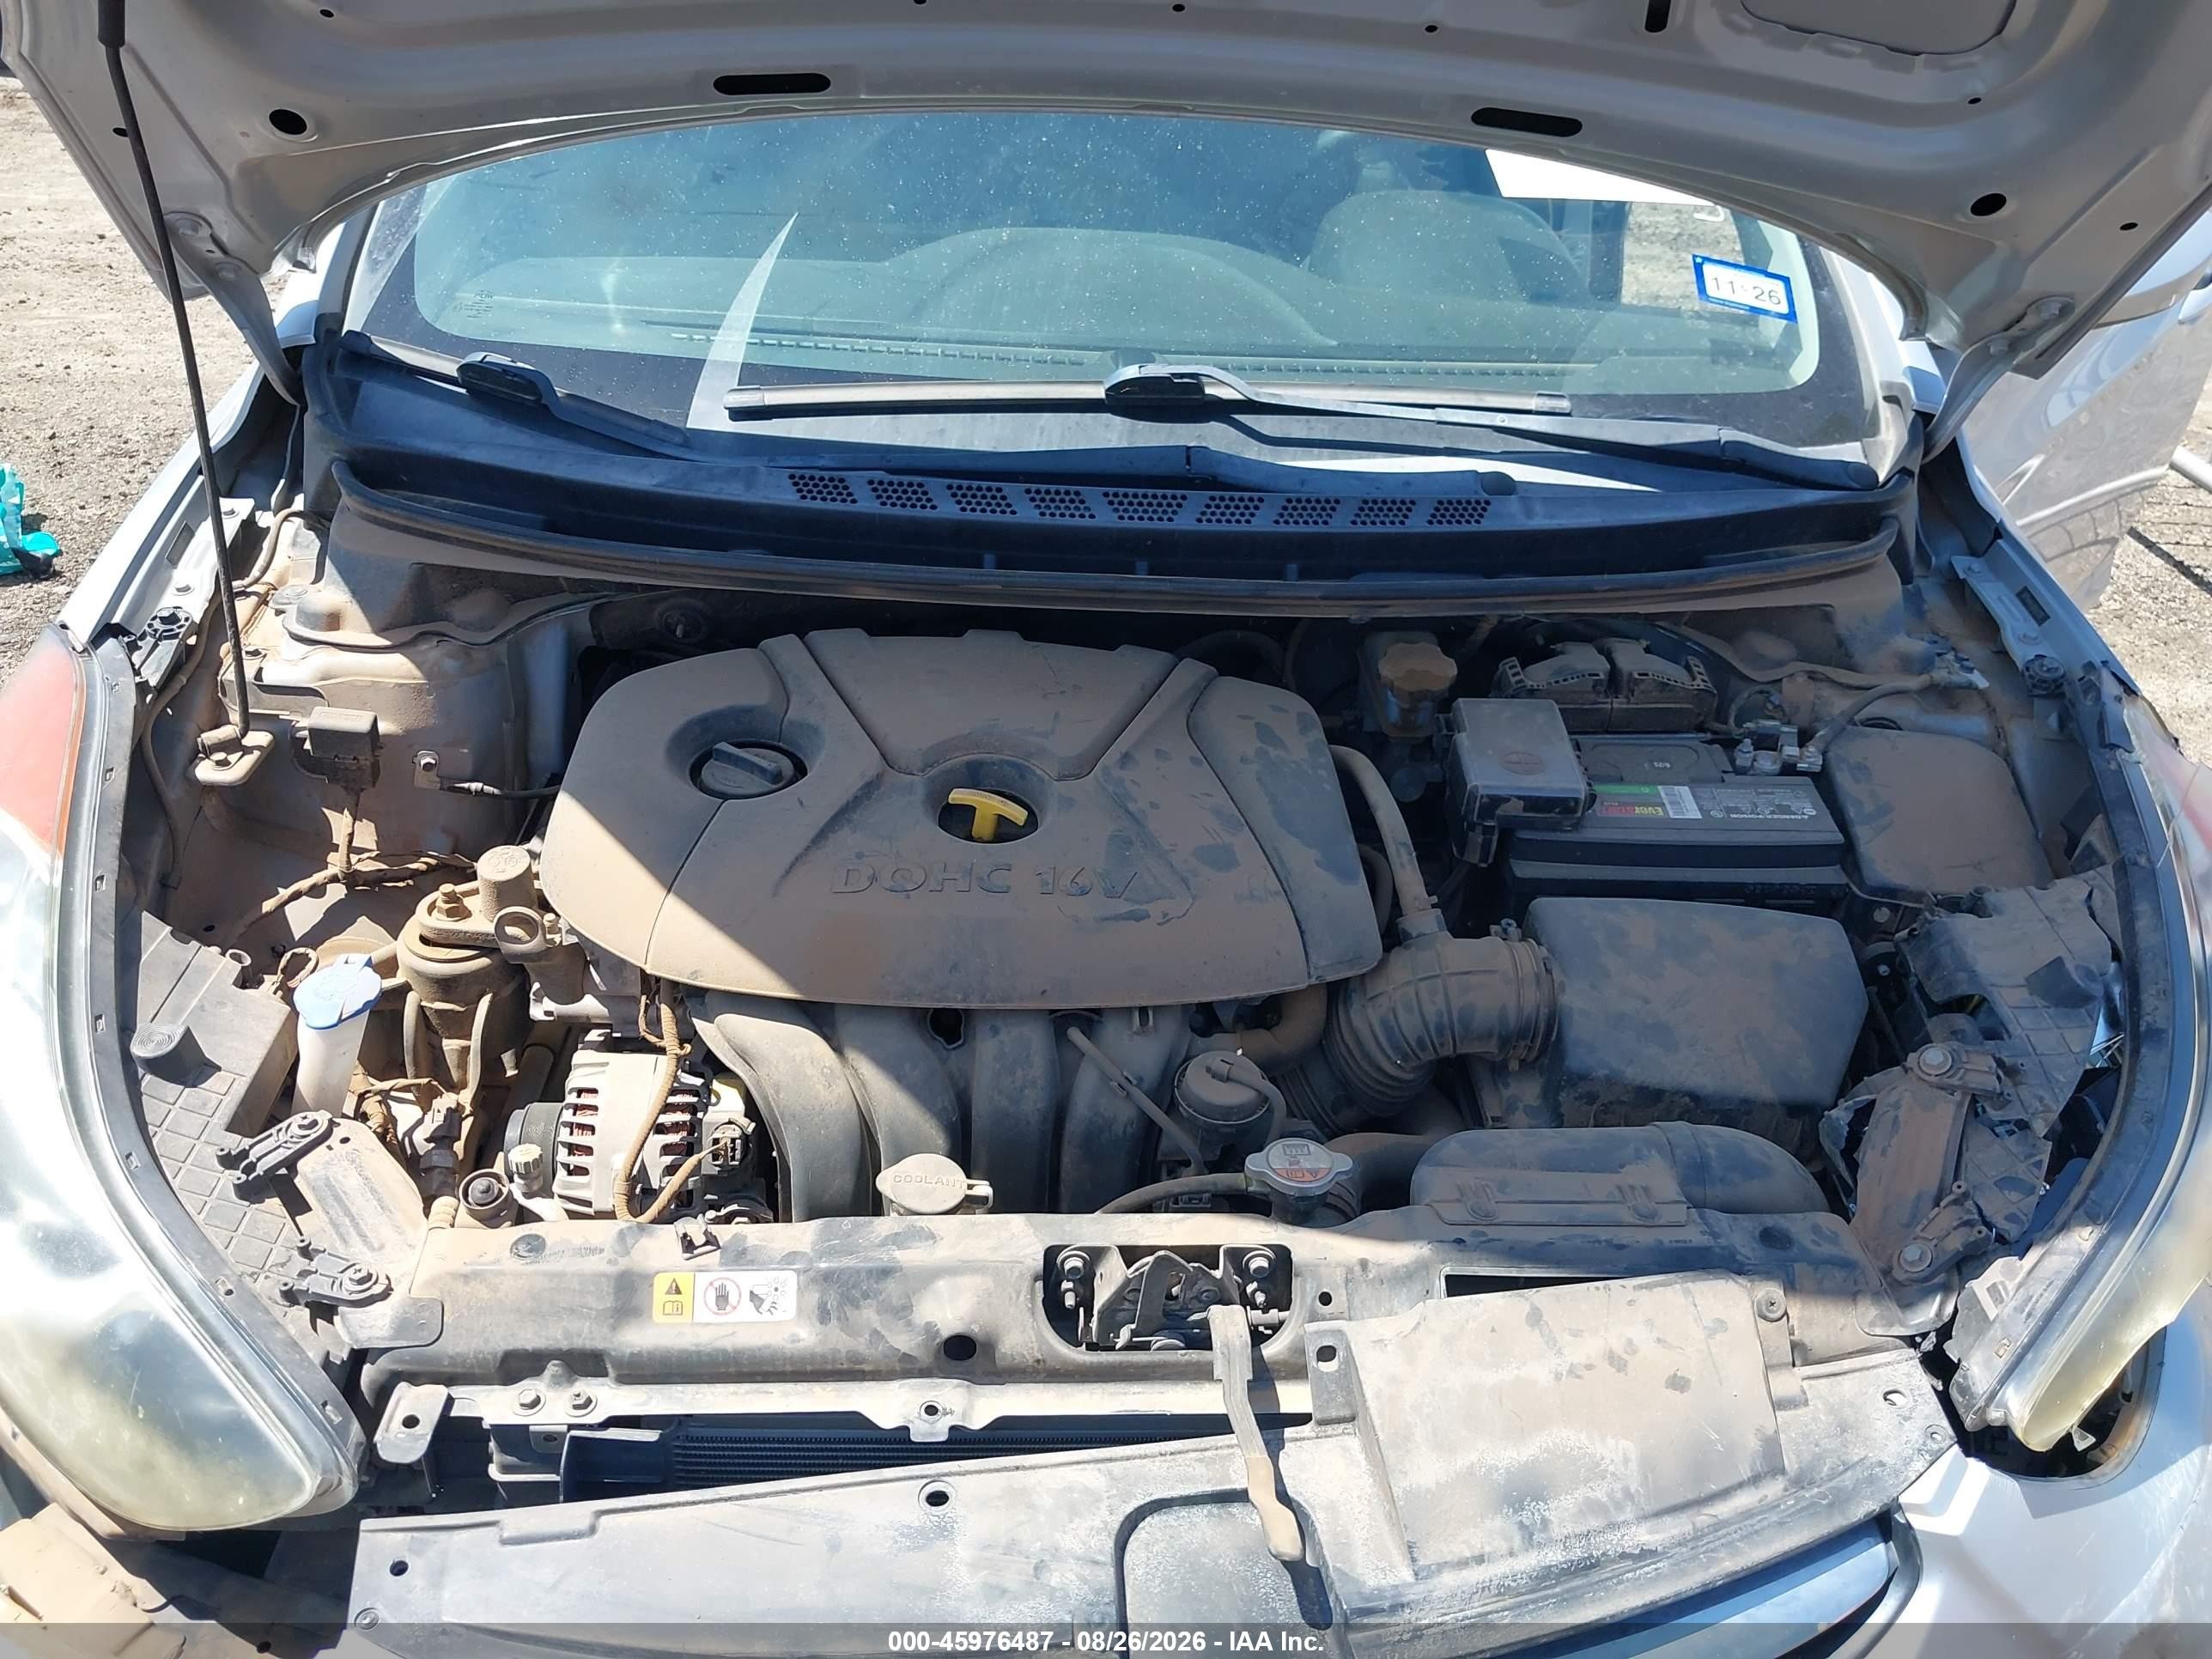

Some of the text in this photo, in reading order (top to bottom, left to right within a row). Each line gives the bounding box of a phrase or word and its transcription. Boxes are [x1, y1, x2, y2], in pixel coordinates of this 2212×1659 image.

[1711, 276, 1736, 295] 11
[1752, 285, 1782, 306] 26
[830, 861, 1138, 899] DOHC 16V
[892, 1174, 967, 1189] COOLANT
